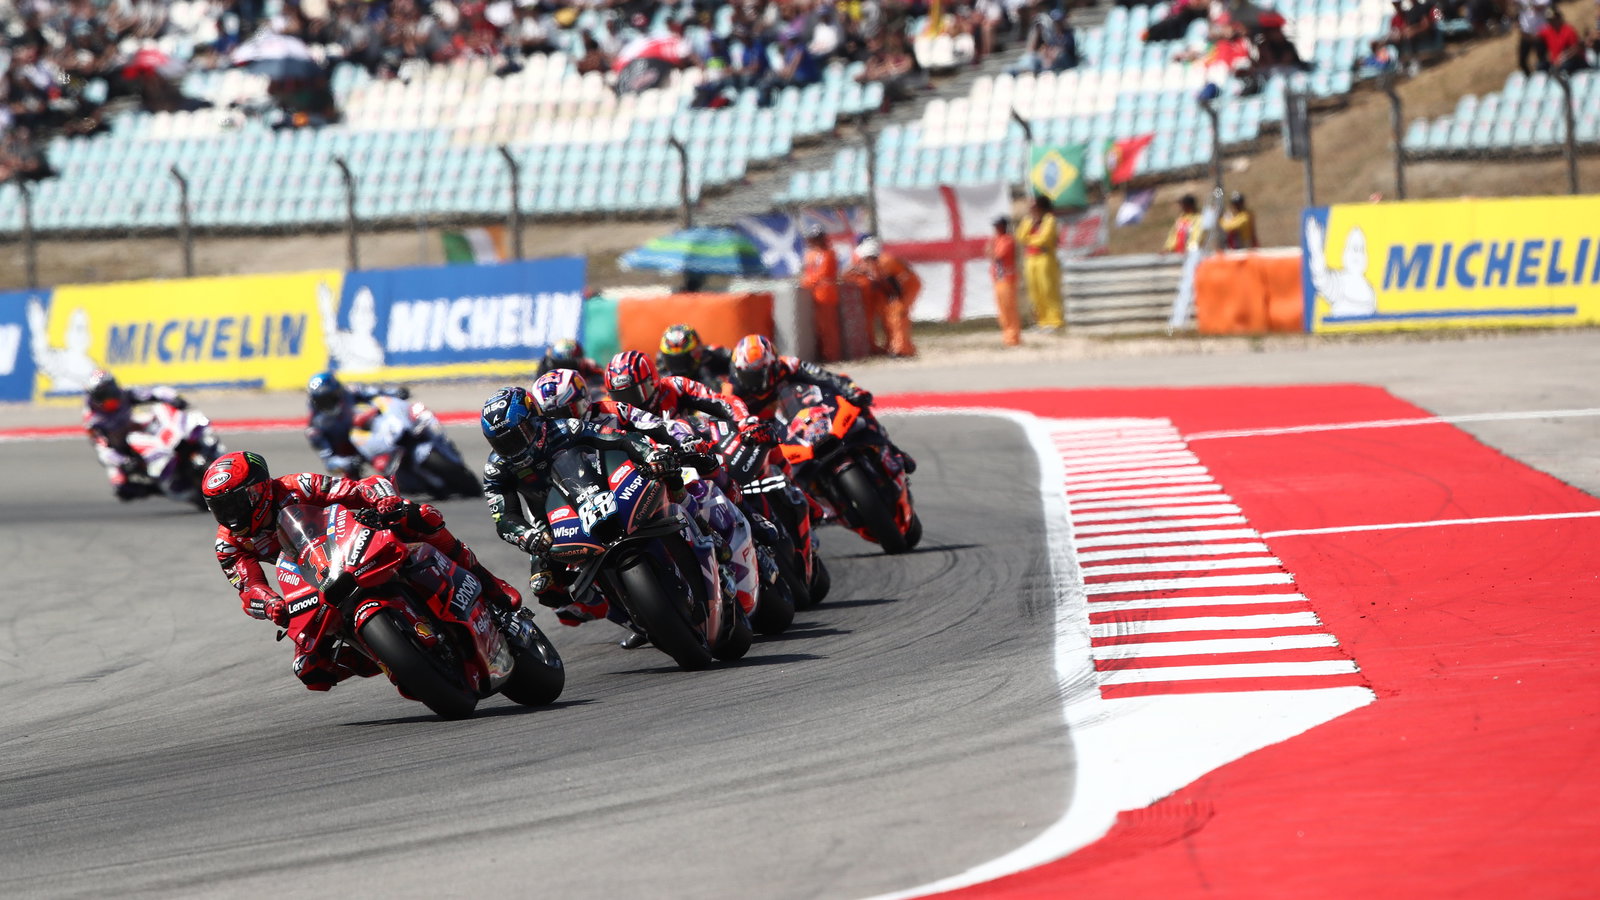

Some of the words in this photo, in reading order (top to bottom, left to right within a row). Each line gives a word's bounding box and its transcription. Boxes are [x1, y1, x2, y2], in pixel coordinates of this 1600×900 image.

[106, 314, 308, 365] MICHELIN
[386, 291, 583, 352] MICHELIN
[619, 475, 645, 501] Wispr
[553, 526, 579, 539] Wispr
[579, 491, 617, 536] 88
[346, 528, 371, 566] Lenovo
[288, 595, 319, 614] Lenovo
